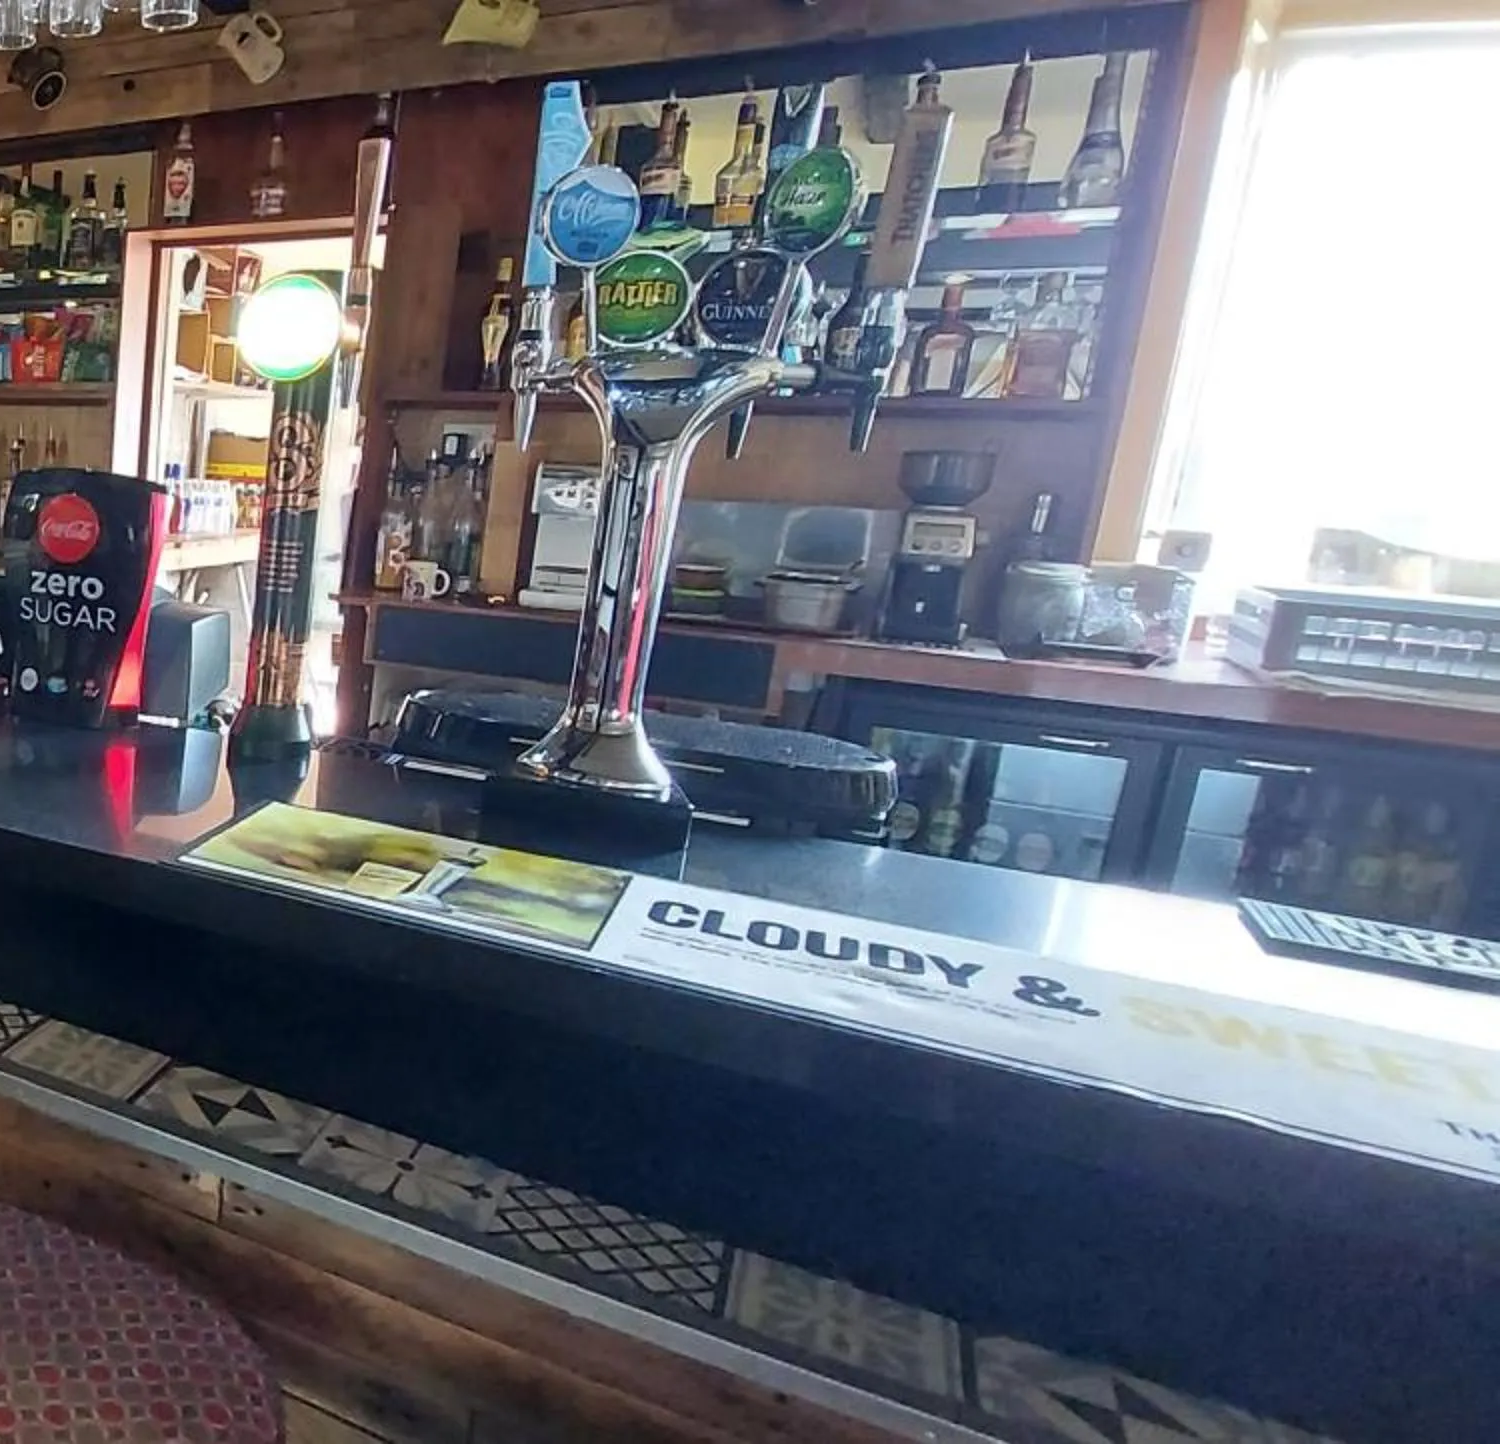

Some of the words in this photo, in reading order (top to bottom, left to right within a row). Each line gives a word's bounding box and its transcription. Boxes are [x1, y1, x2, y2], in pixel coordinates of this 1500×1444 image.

[702, 302, 770, 323] GUINNE
[30, 570, 105, 599] zero
[19, 597, 117, 633] SUGAR
[647, 899, 984, 989] CLOUDY
[1012, 974, 1101, 1018] &
